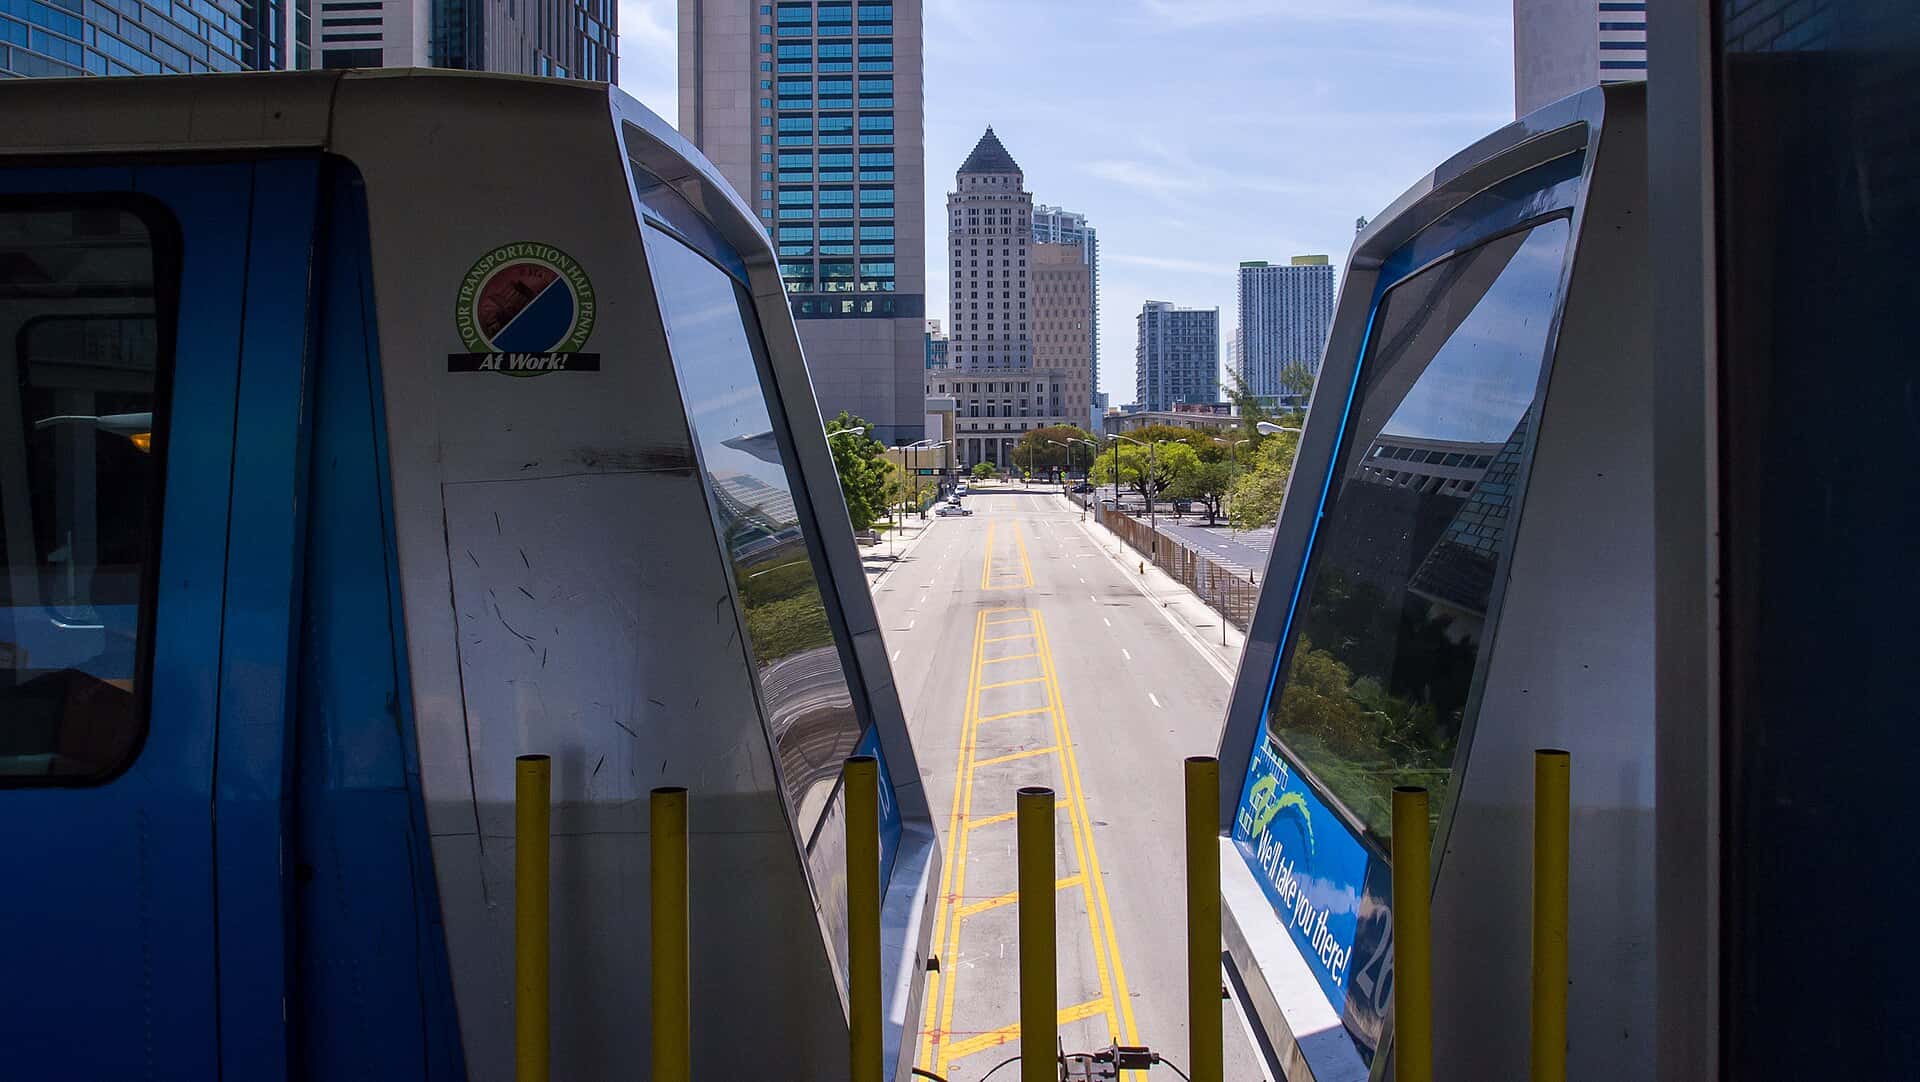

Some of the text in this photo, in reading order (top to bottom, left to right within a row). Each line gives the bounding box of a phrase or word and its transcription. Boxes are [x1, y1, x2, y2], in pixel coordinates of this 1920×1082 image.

[458, 244, 593, 349] YOUR TRANSPORTATION HALF PENNY
[479, 353, 569, 370] At Work!
[1257, 824, 1352, 986] We'll take you there!
